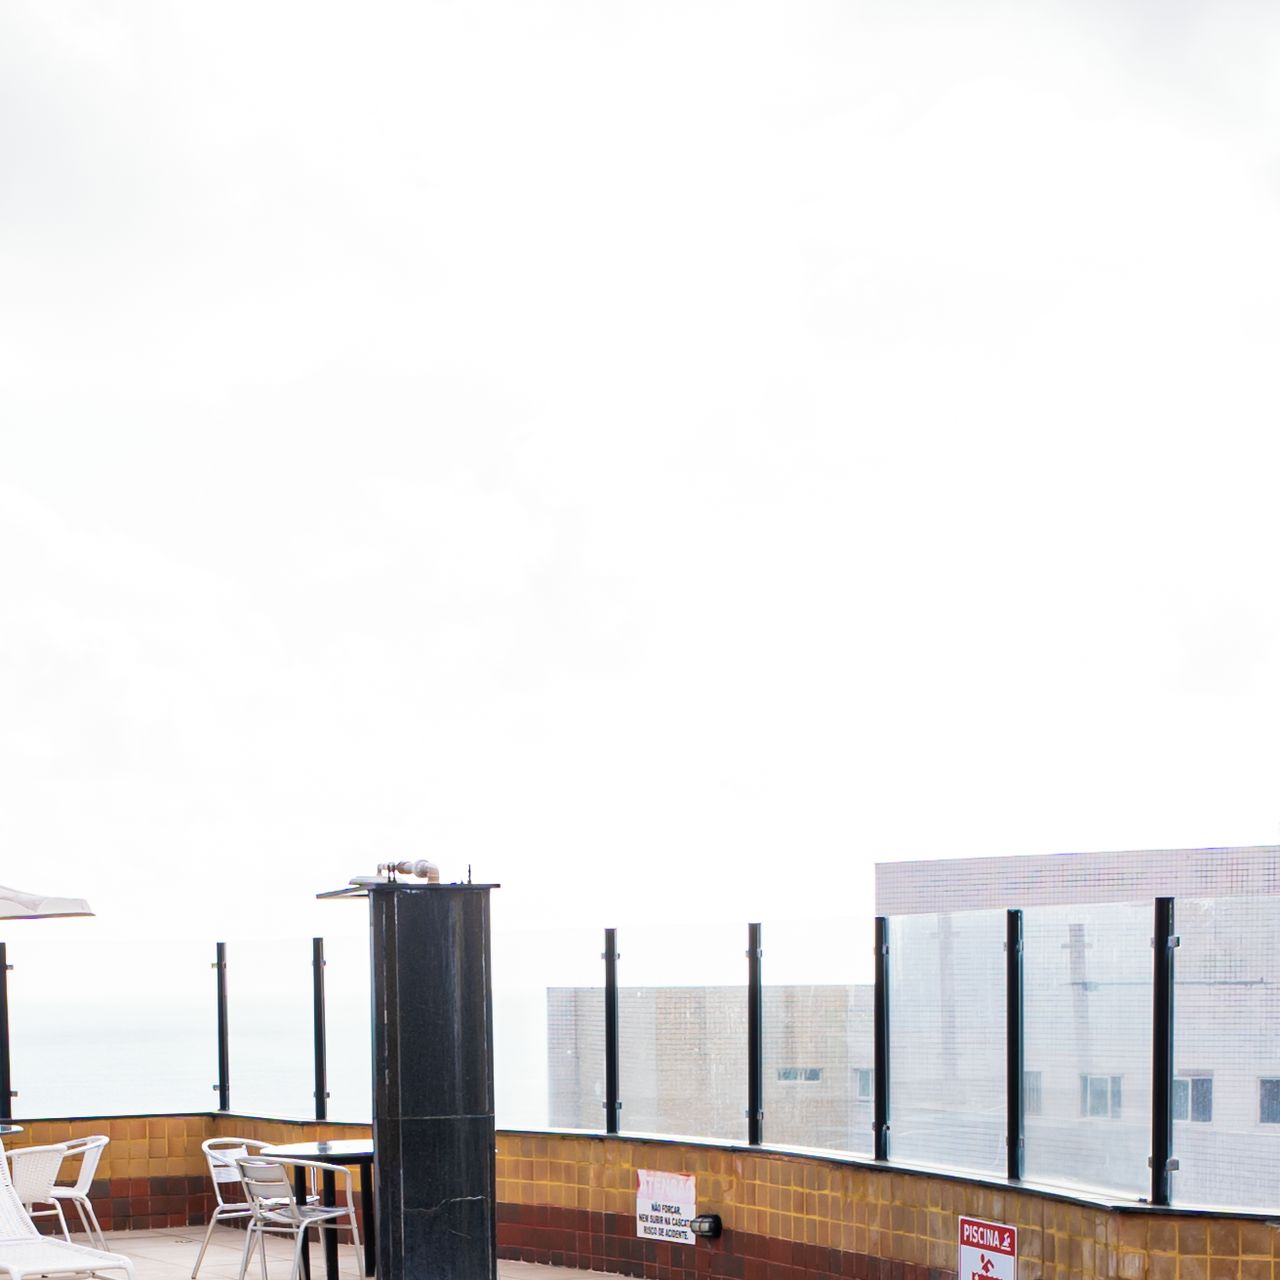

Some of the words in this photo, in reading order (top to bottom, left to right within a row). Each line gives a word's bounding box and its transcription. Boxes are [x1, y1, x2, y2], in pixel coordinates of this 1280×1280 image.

[651, 1200, 661, 1212] NÃO
[639, 1213, 648, 1222] NEM
[665, 1217, 671, 1225] NA
[643, 1225, 657, 1235] RISCO
[658, 1228, 664, 1236] DE
[963, 1224, 1000, 1248] PISCINA
